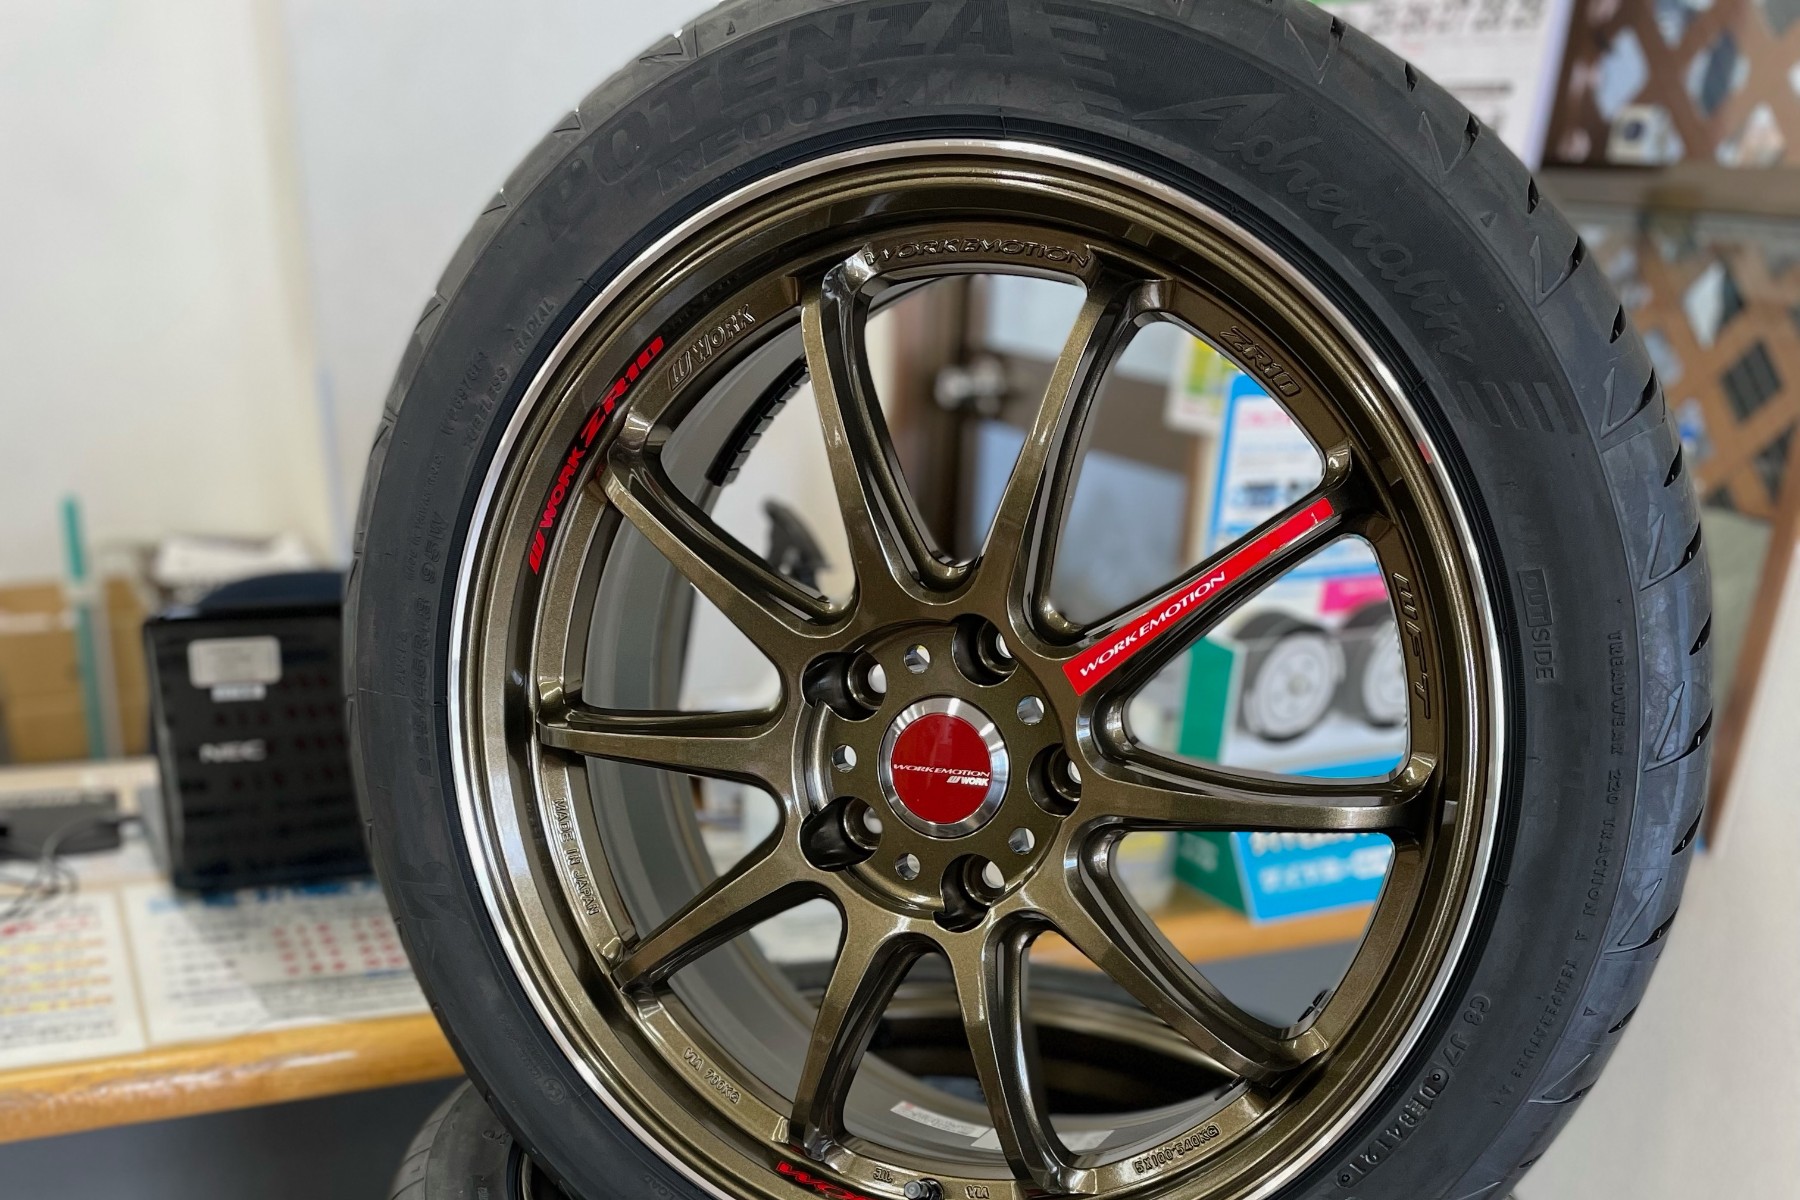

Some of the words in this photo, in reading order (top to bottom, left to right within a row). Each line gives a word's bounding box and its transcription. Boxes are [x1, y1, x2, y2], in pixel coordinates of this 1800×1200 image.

[1607, 630, 1626, 757] TREADWEAR
[960, 776, 989, 787] WORK
[1607, 769, 1624, 806] 220
[554, 797, 574, 843] MADE
[563, 847, 582, 867] IN
[1583, 818, 1619, 917] TRACTION
[573, 867, 600, 916] JAPAN
[1512, 957, 1579, 1081] TEMPERATURE
